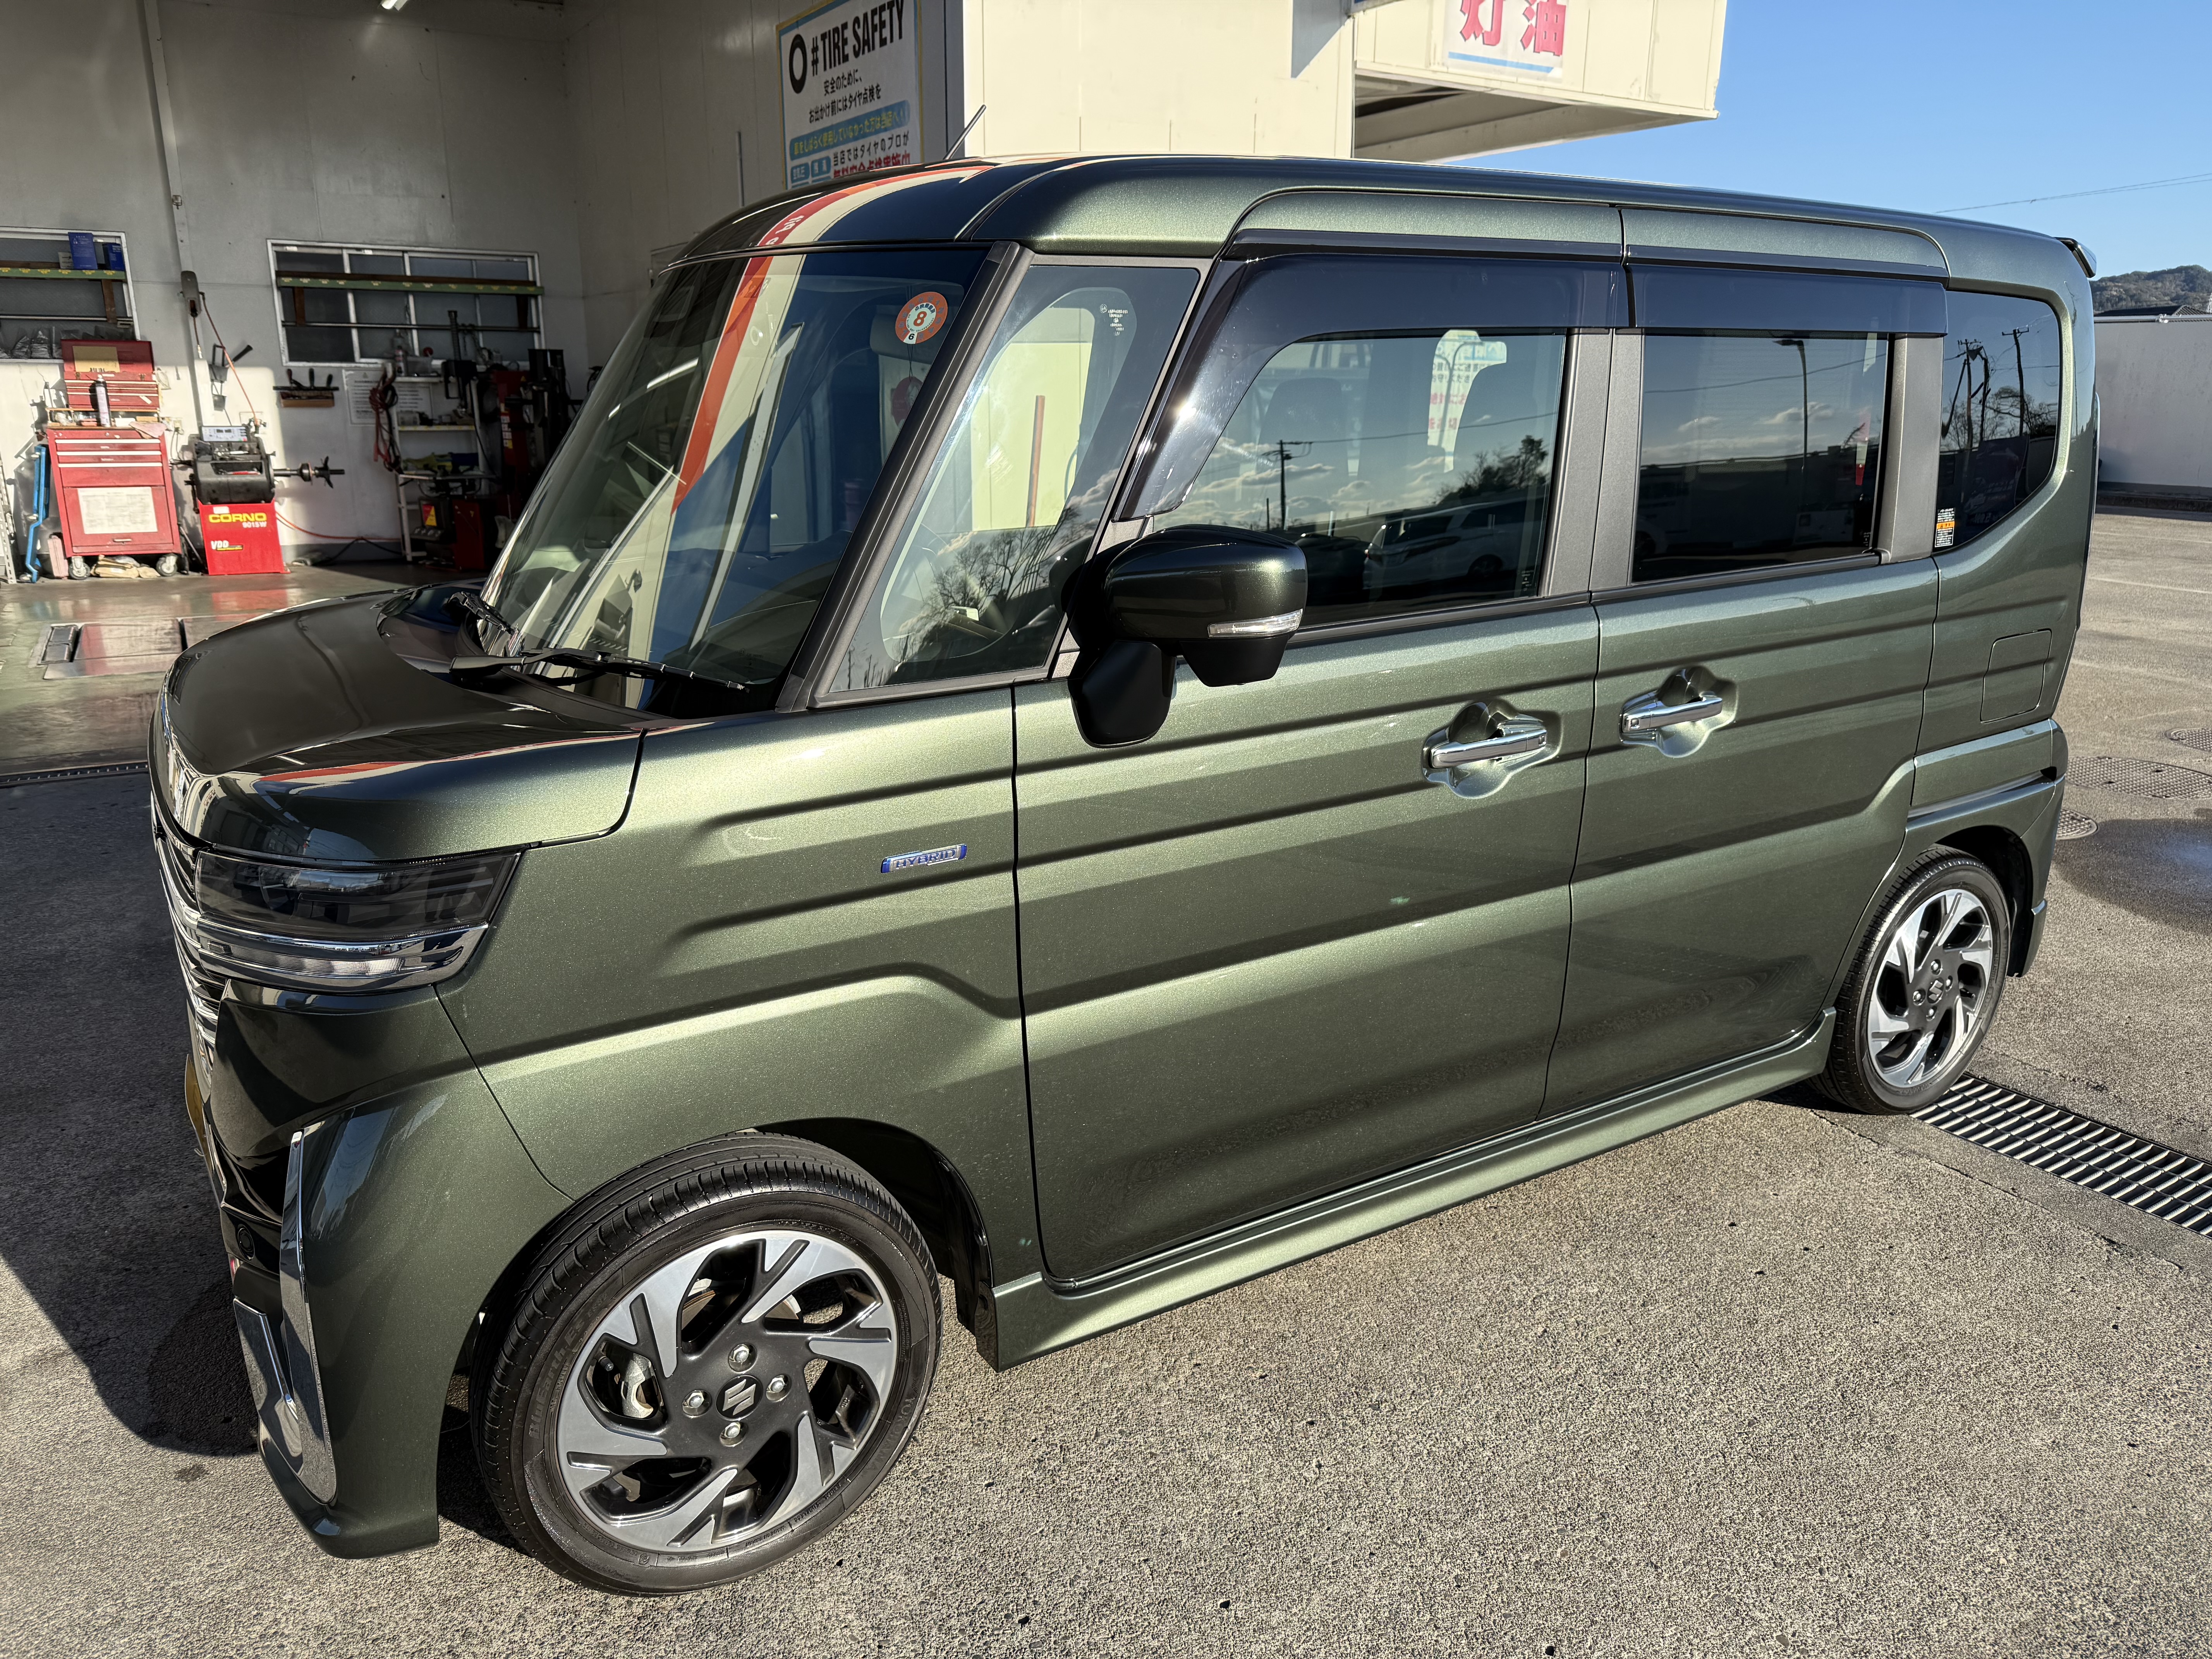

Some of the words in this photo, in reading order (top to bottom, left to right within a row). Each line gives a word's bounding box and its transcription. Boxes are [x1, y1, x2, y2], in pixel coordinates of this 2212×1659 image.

[852, 0, 904, 58] SAFETY
[1460, 0, 1566, 57] 灯油
[809, 83, 881, 124] お出かけ前にはタイヤ点検を
[833, 130, 909, 167] 当店ではタイヤのプロが
[913, 311, 927, 326] 8
[209, 512, 267, 523] CORNO
[211, 540, 229, 550] VDD
[896, 850, 956, 869] HYBRID
